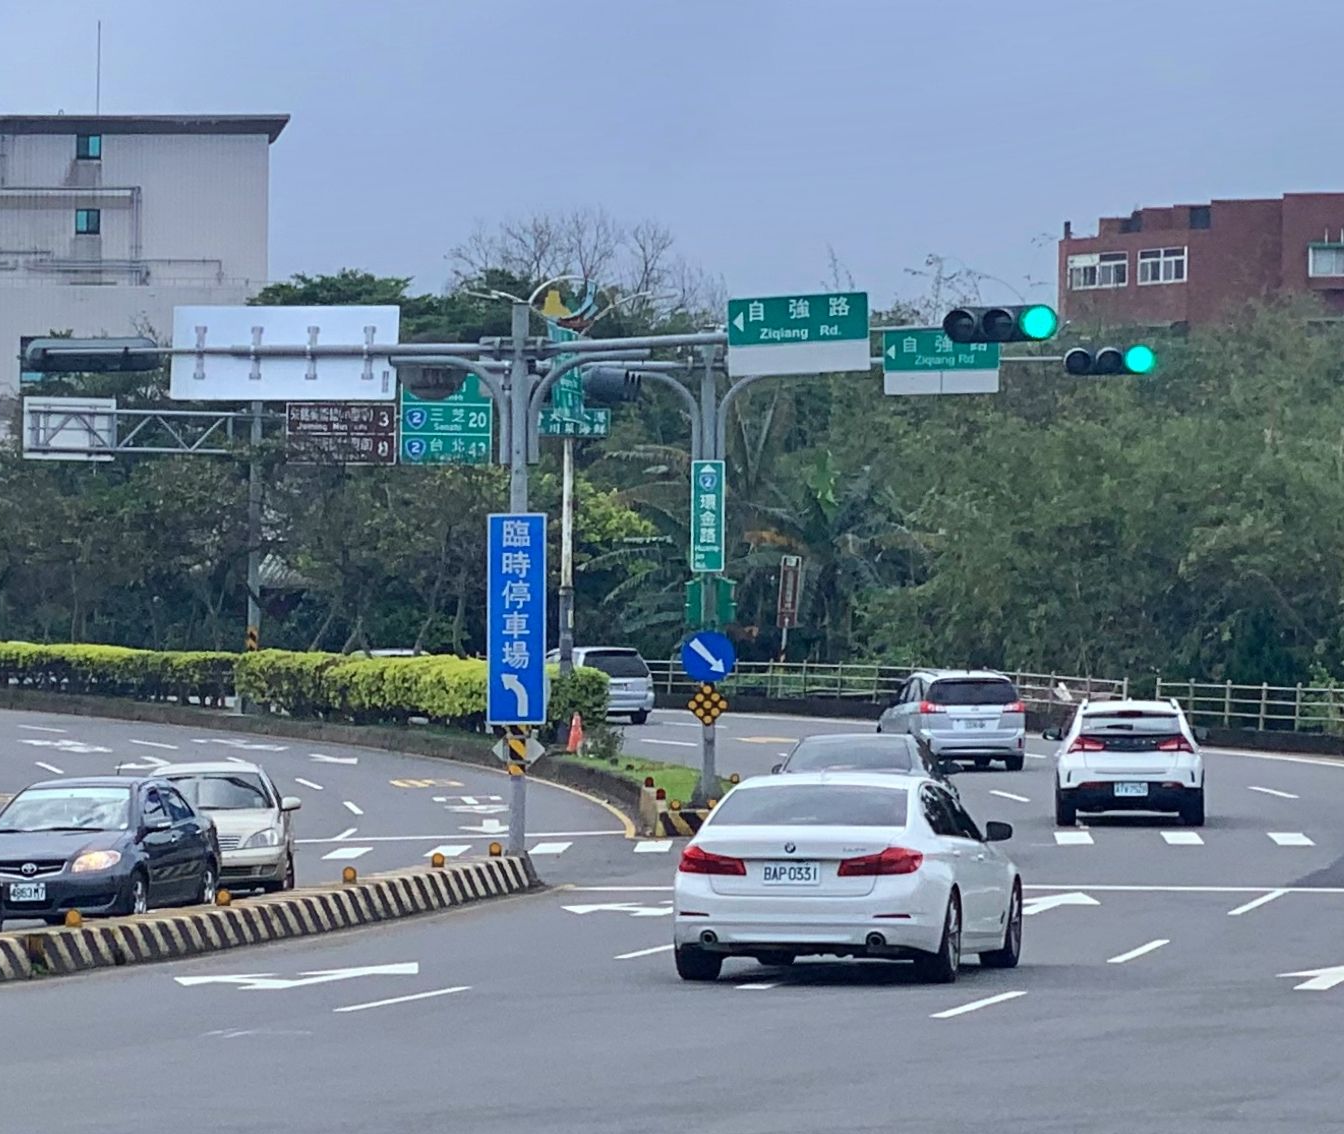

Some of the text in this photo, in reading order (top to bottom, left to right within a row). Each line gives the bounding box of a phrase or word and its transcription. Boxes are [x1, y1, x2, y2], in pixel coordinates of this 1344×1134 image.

[748, 296, 851, 323] 自強路
[760, 324, 842, 340] Ziqiang Rd.
[378, 411, 390, 427] 3
[412, 412, 421, 423] 2
[430, 408, 465, 422] 三芝
[468, 411, 487, 428] 20
[411, 441, 420, 453] 2
[429, 437, 465, 452] 台北
[501, 519, 531, 669] 臨時停車場
